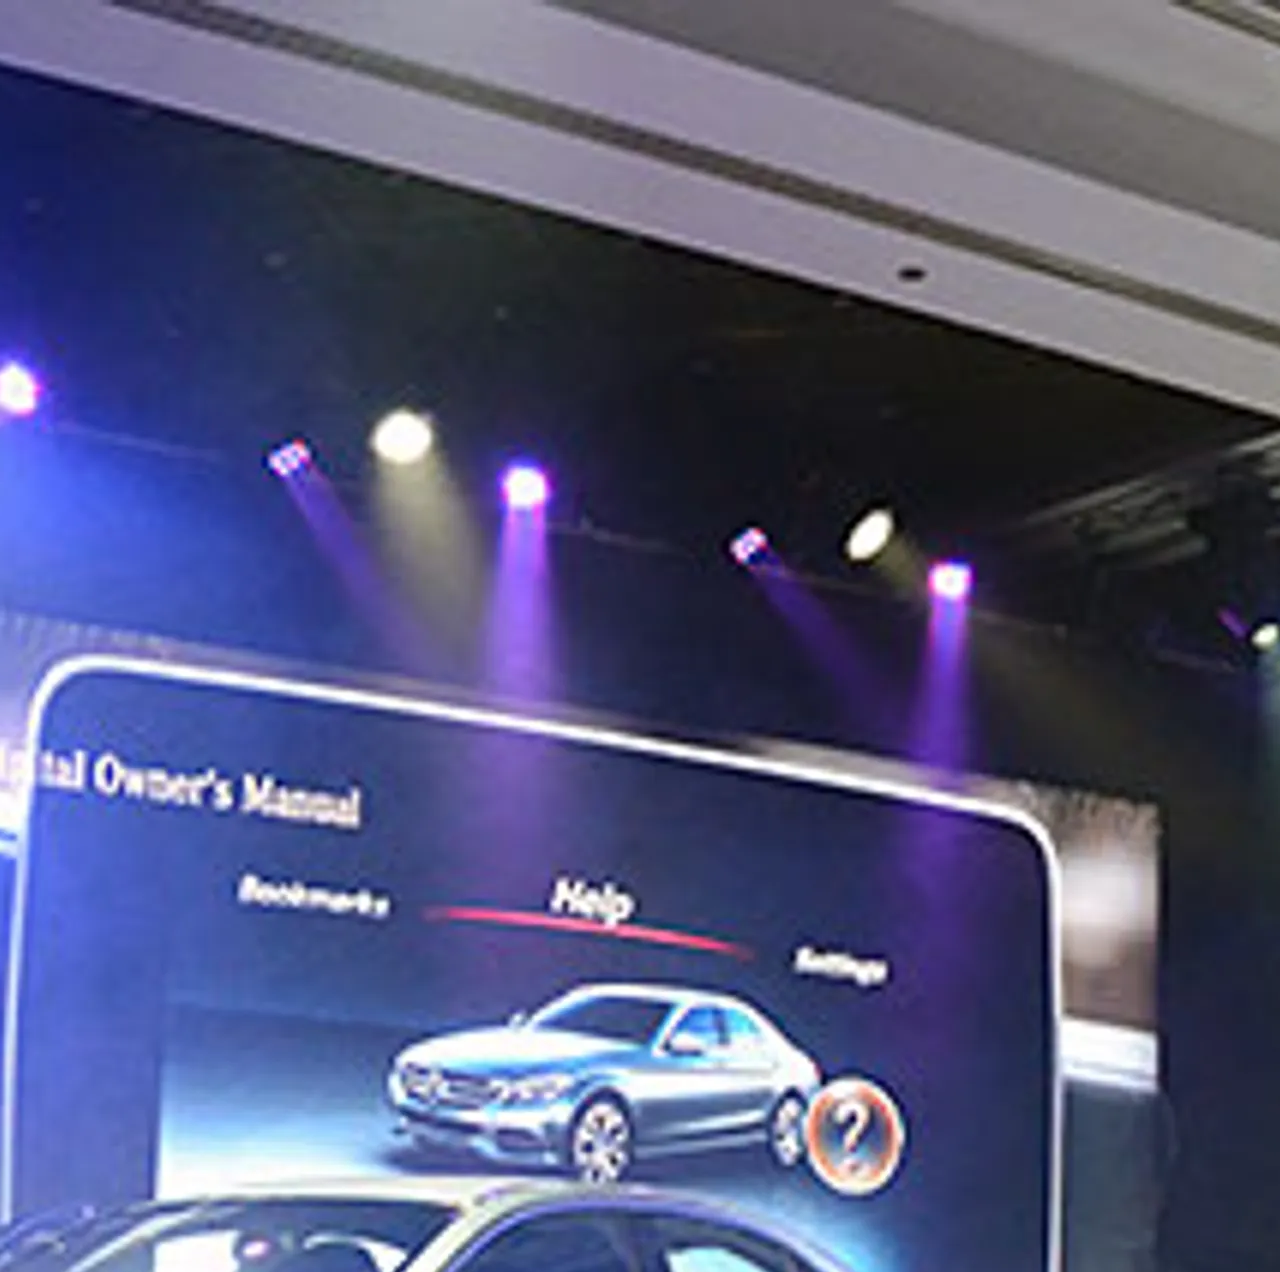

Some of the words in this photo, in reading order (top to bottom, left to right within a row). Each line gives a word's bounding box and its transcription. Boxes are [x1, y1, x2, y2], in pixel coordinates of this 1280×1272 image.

[94, 751, 233, 810] Owner's
[242, 773, 362, 828] Manual
[549, 877, 636, 928] Help
